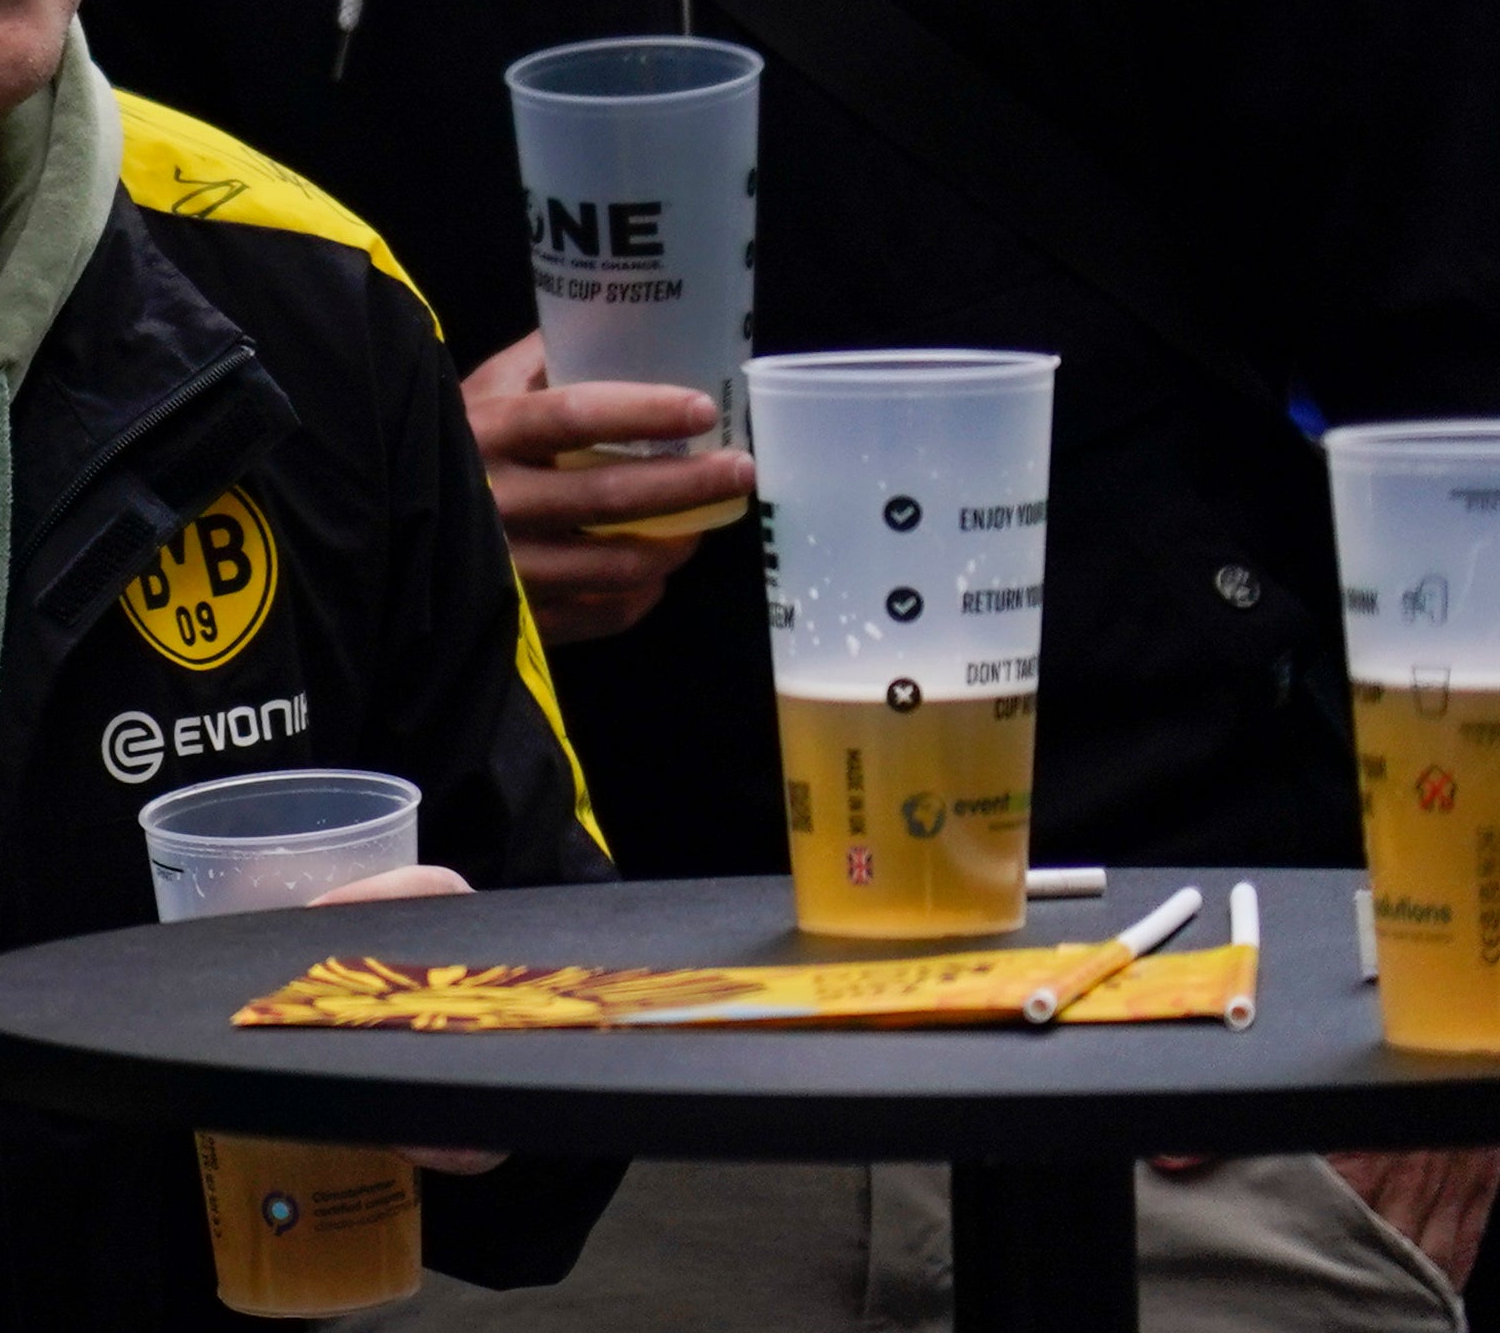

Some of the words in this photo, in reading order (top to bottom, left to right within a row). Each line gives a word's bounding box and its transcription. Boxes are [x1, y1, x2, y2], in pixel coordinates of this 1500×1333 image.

[568, 278, 602, 303] CUP
[605, 278, 684, 304] SYSTEM
[959, 504, 1015, 533] ENJOY
[961, 586, 1025, 615] RETURN
[175, 600, 219, 647] 09
[965, 658, 1012, 687] DON'T
